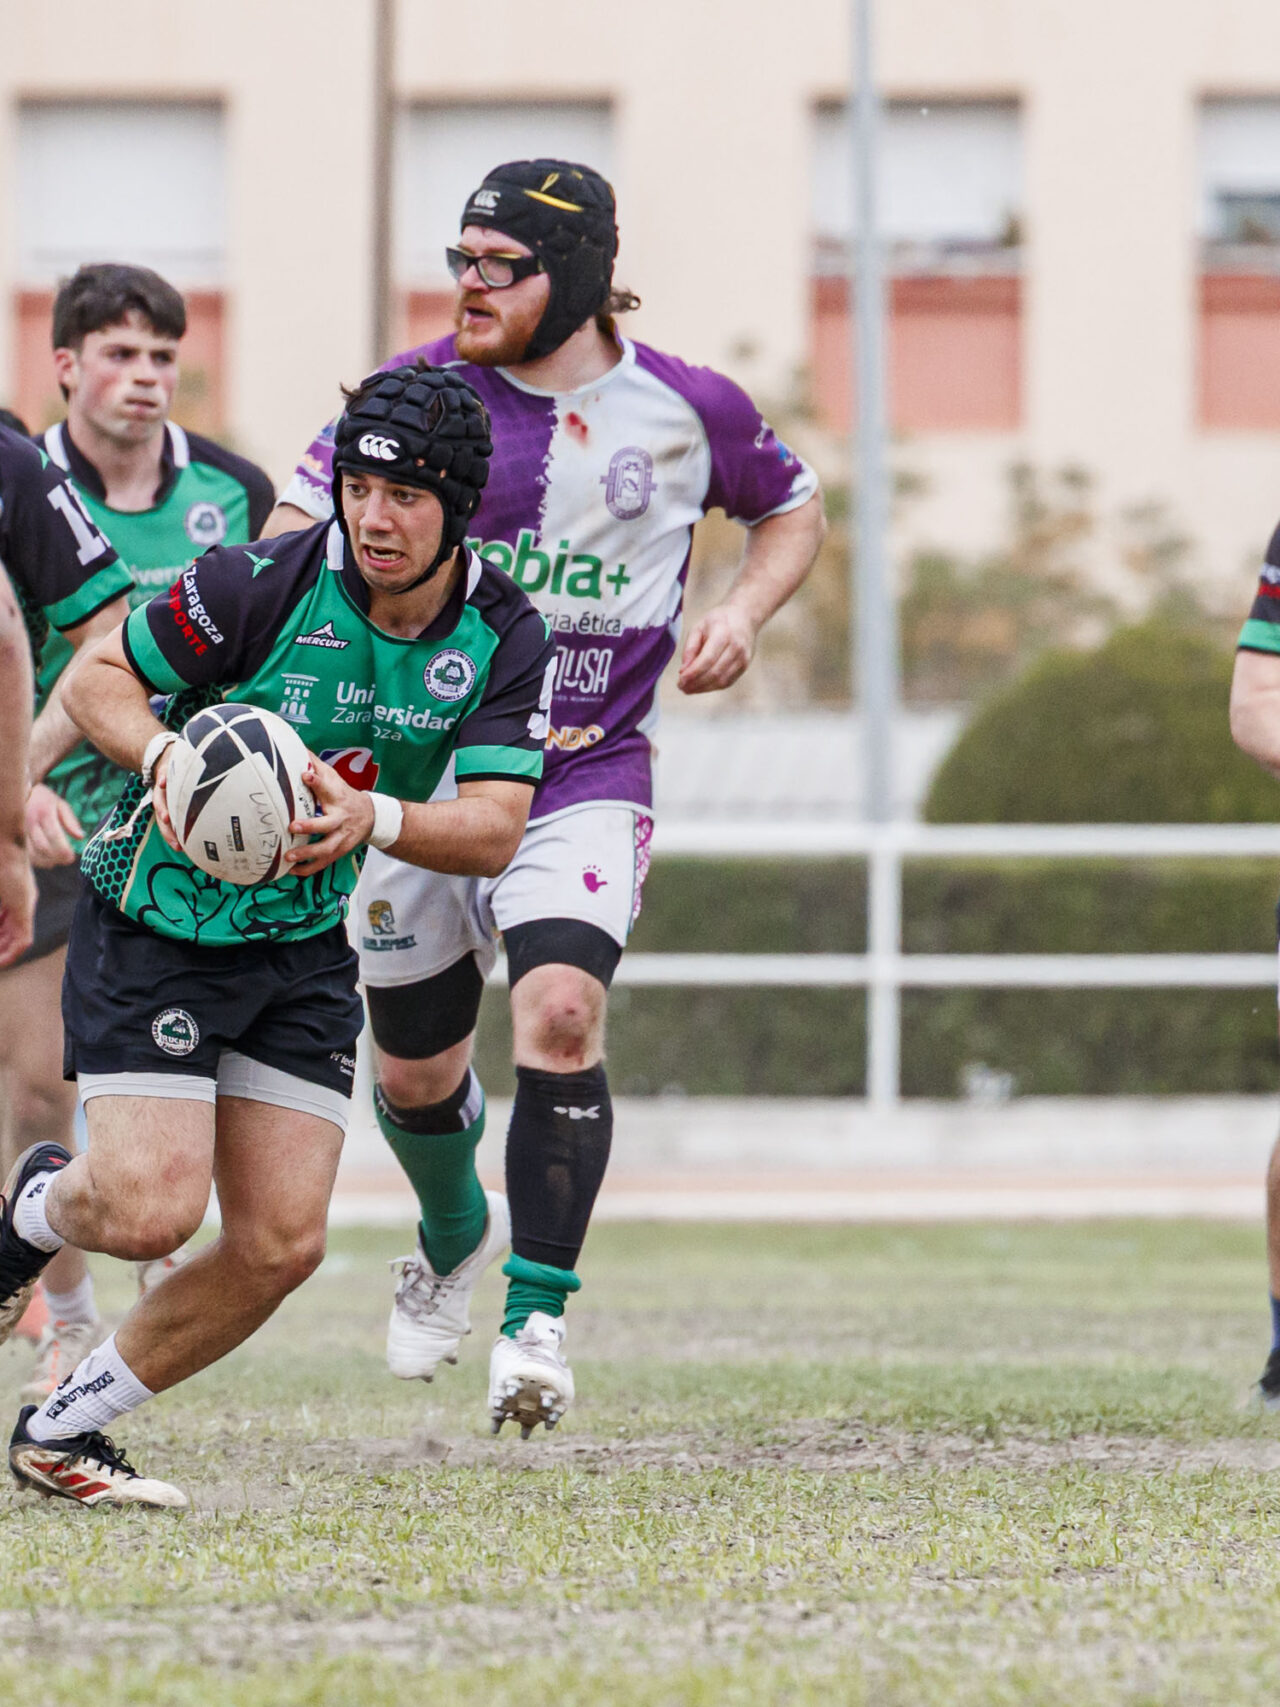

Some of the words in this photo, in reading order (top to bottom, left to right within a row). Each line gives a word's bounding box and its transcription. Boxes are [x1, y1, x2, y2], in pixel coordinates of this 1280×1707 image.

[183, 566, 224, 645] Zaragoza
[578, 611, 621, 635] ética
[296, 634, 349, 650] MERCURY
[331, 706, 403, 742] Zaraoza
[336, 681, 461, 731] Uniersidad
